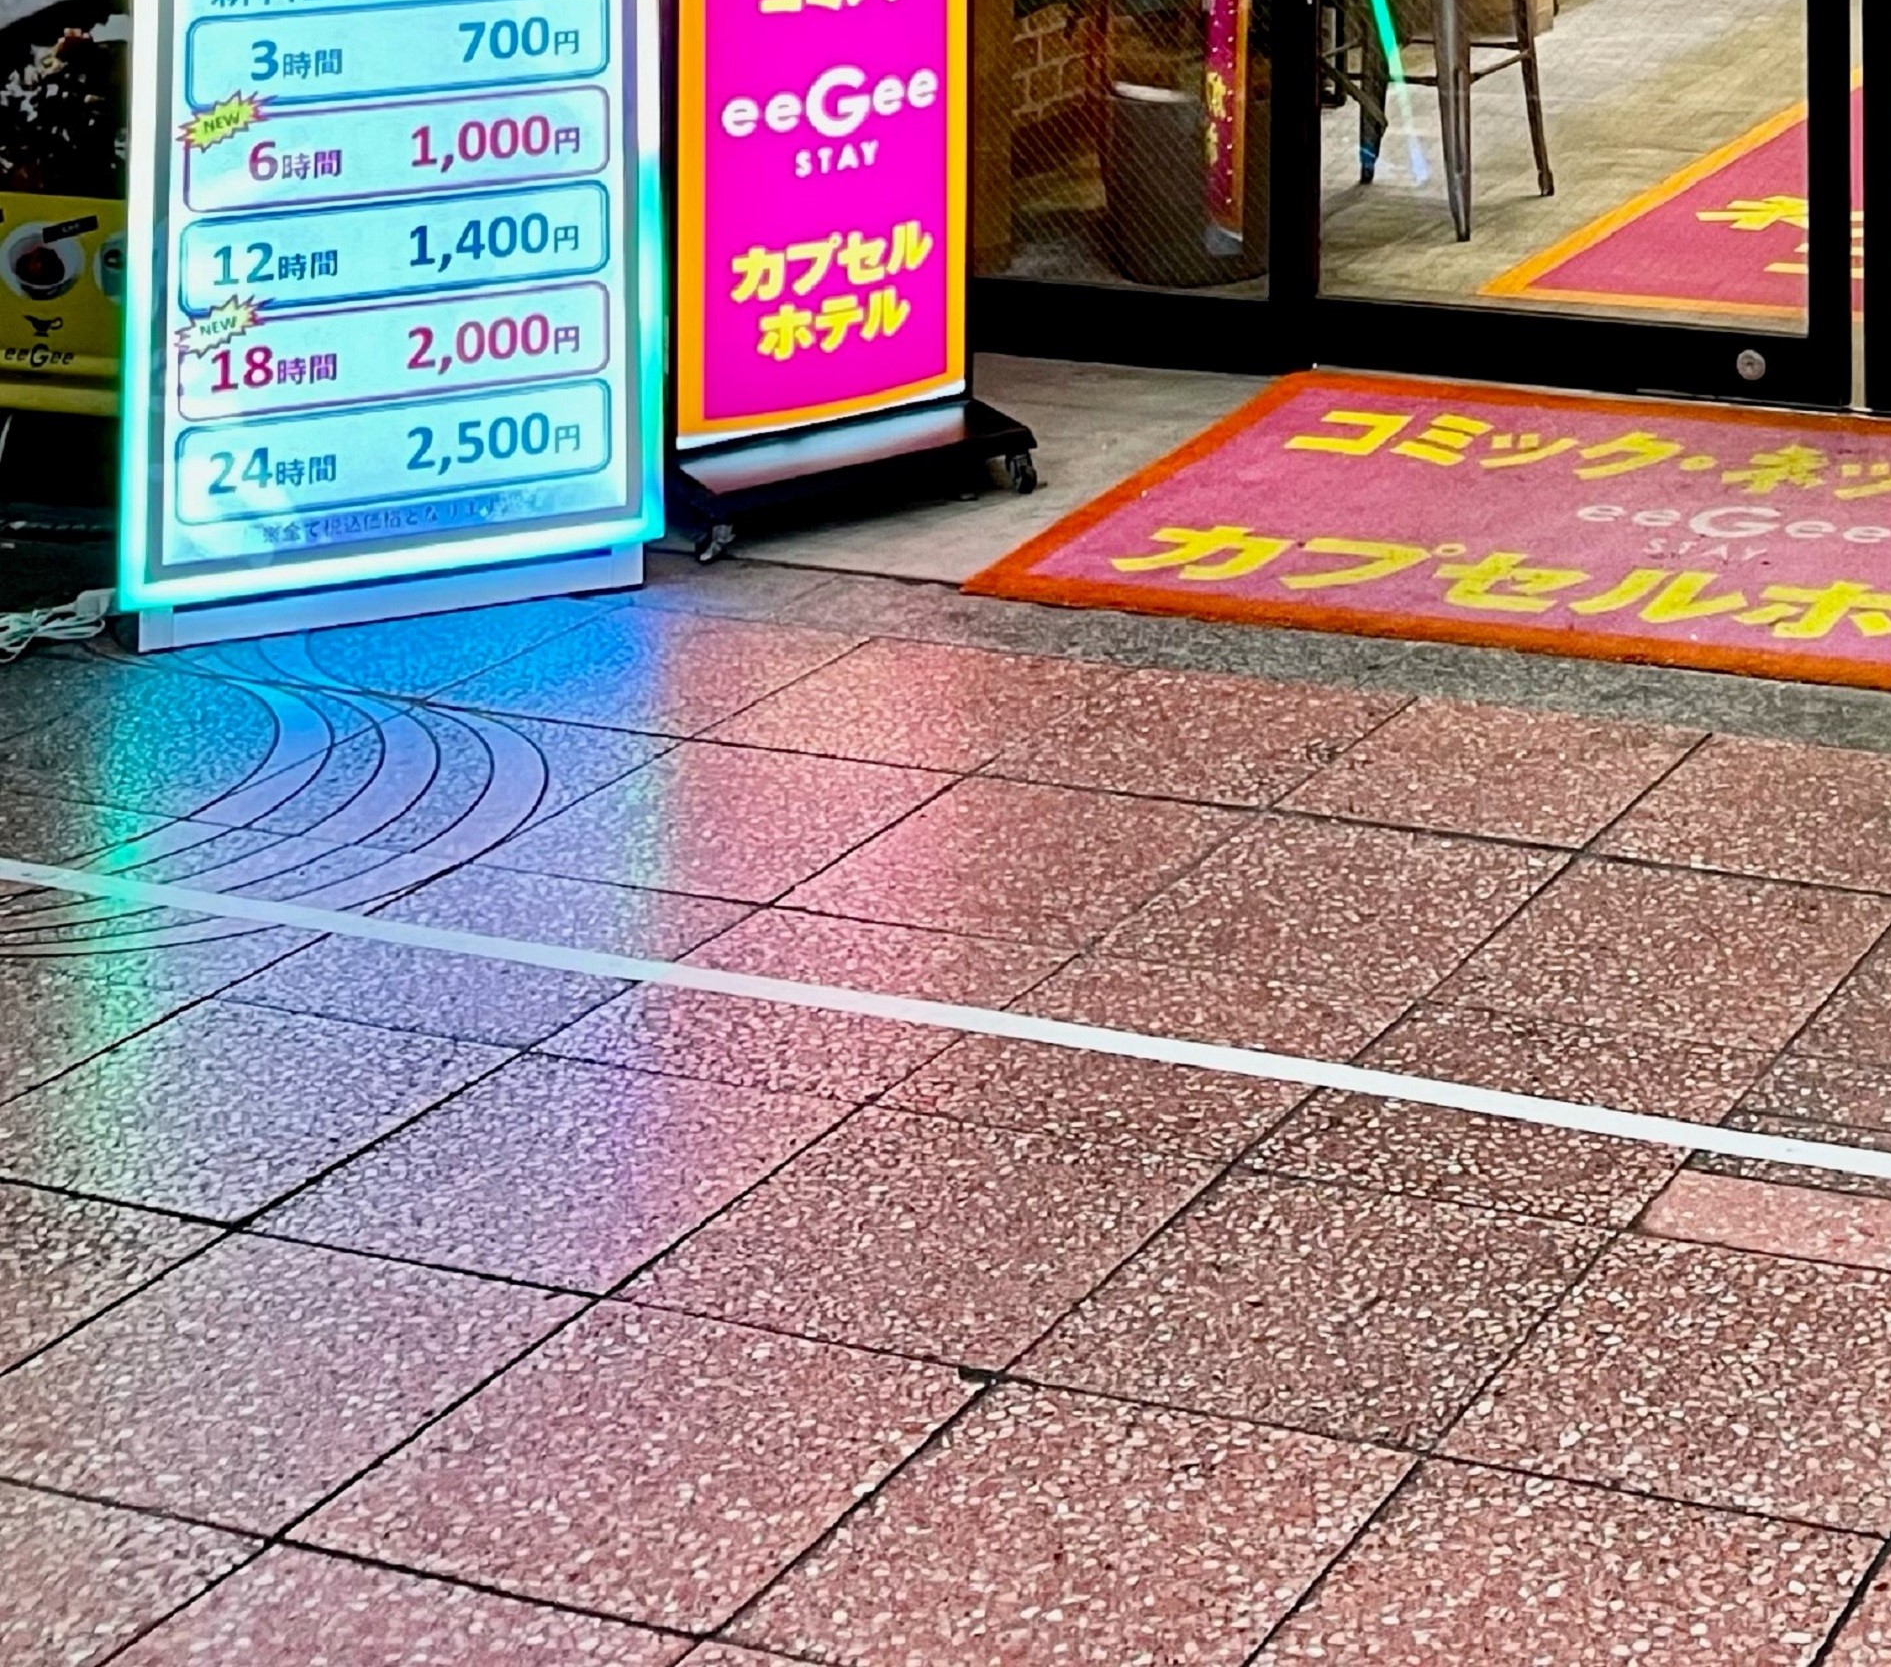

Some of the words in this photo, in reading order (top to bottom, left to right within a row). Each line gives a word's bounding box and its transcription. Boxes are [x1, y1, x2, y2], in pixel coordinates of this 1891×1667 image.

[250, 38, 343, 80] 3時間
[458, 16, 580, 61] 700円
[203, 110, 241, 132] NEW
[722, 65, 939, 137] eeGee
[248, 141, 342, 181] 6時間
[411, 115, 580, 172] 1,000円
[796, 140, 879, 176] STAY
[213, 242, 338, 286] 12時間
[410, 212, 578, 272] 1,400円
[732, 221, 933, 303] カプセル
[5, 343, 74, 367] eeGee
[200, 315, 237, 336] NEW
[211, 346, 337, 392] 18時間
[407, 313, 580, 374] 2,000円
[758, 290, 909, 360] ホテル
[208, 447, 336, 495] 24時間
[407, 412, 581, 474] 2,500円
[1576, 504, 1891, 545] eeGee
[1644, 537, 1769, 563] STAY
